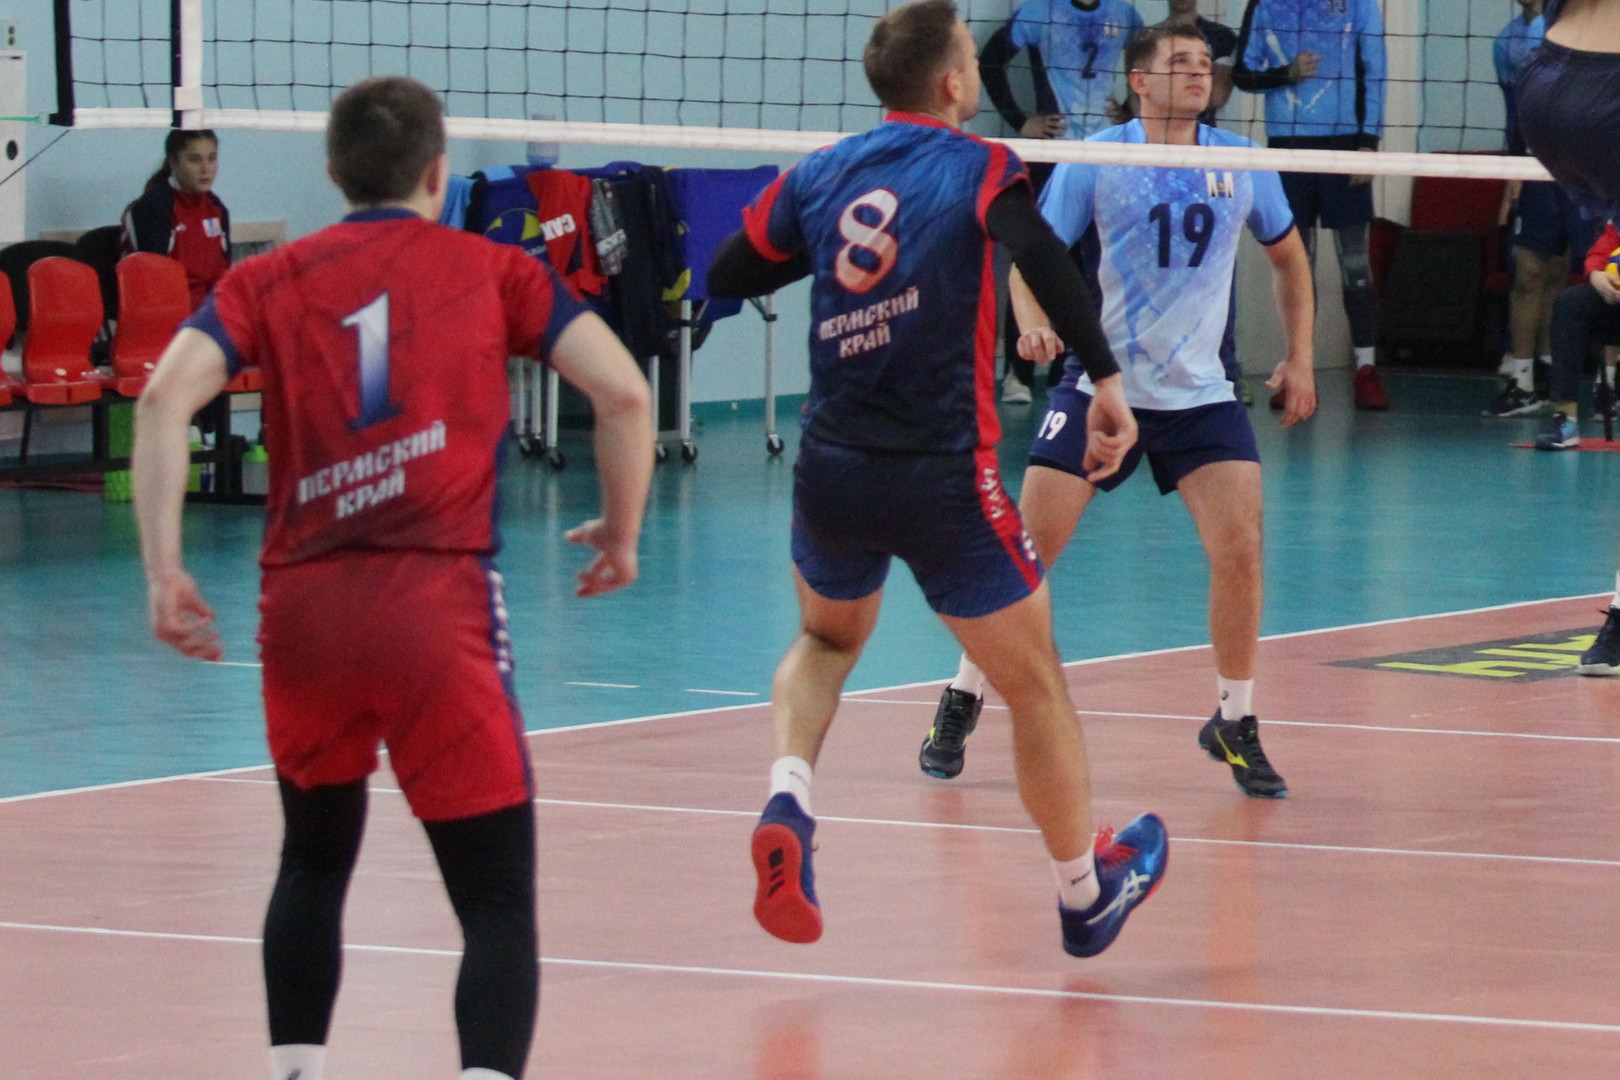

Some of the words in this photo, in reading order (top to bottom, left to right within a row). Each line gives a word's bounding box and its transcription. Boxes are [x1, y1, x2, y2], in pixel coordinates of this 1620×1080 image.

[1081, 42, 1098, 80] 2
[835, 187, 899, 295] 8
[1150, 202, 1215, 268] 19
[818, 285, 920, 341] ПЕРМСКИЙ
[838, 321, 892, 359] КРАЙ
[340, 289, 405, 433] 1
[1037, 409, 1068, 441] 19
[296, 419, 447, 506] ПЕРМСКИЙ
[335, 466, 406, 519] КРАЙ
